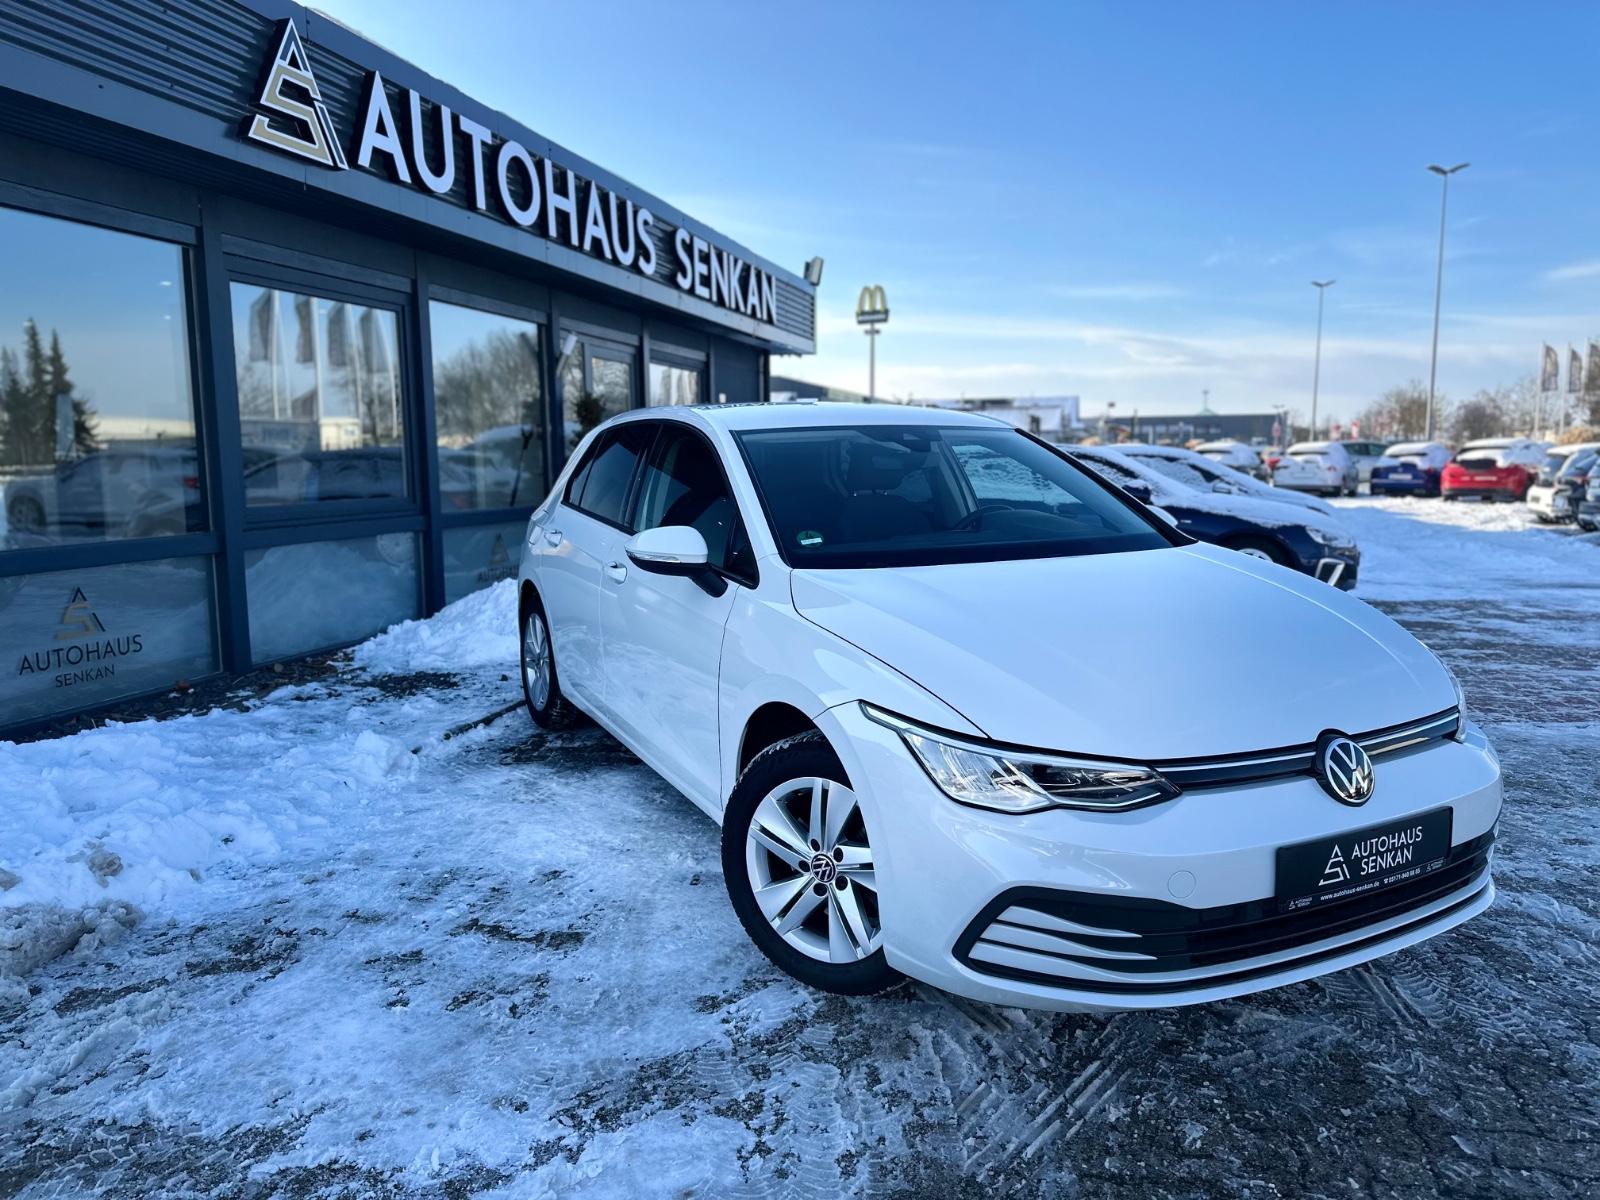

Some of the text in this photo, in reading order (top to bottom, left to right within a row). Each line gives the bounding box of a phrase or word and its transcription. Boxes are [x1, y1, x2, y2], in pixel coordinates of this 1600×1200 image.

[357, 70, 777, 325] AUTOHAUS SENKAN
[19, 634, 143, 676] AUTOHAUS
[55, 664, 115, 688] SENKAN
[1351, 826, 1423, 860] AUTOHAUS
[1360, 845, 1413, 876] SENKAN
